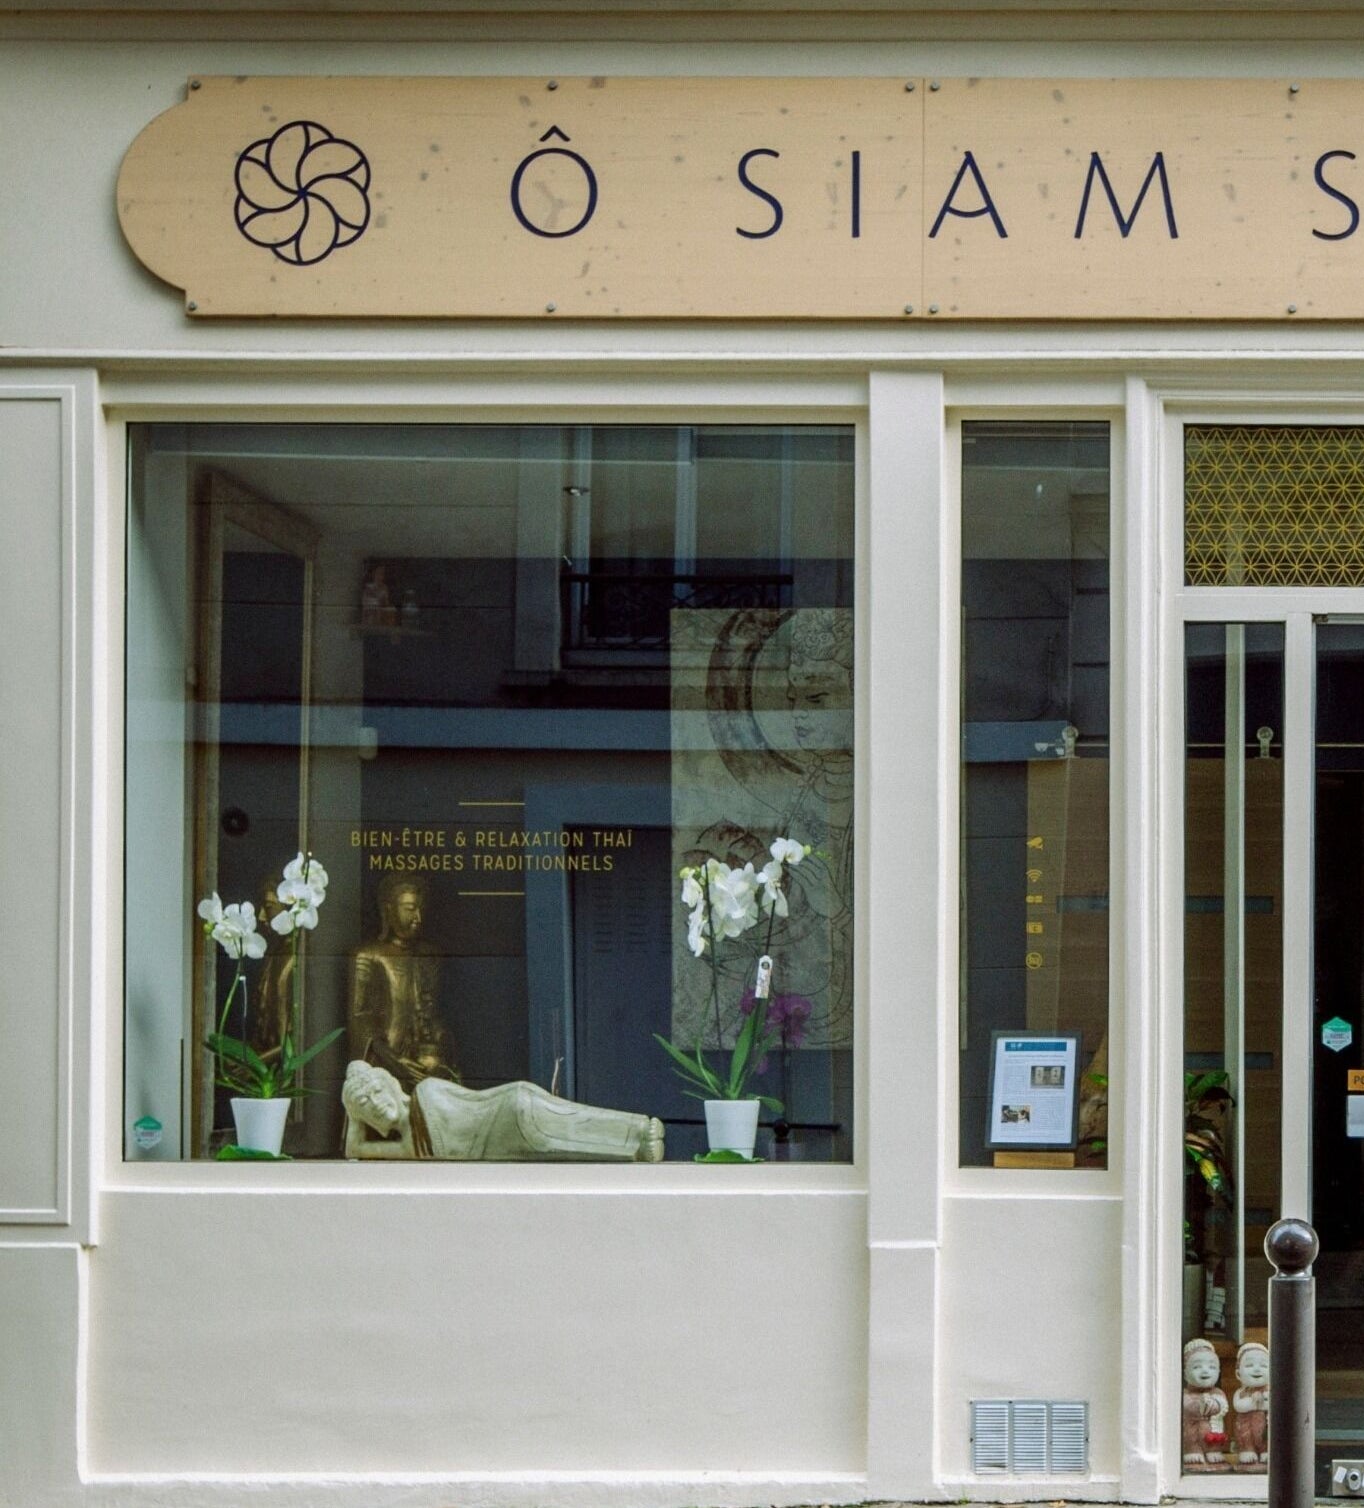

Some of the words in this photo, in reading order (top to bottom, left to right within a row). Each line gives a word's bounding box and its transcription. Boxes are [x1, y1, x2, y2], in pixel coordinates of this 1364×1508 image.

[509, 124, 598, 239] Ô
[735, 148, 1180, 240] SIAM
[350, 828, 446, 847] BIEN-ÊTRE
[455, 831, 466, 847] &
[475, 831, 584, 847] RELAXATION
[592, 830, 633, 847] THAÏ
[369, 854, 464, 871] MASSAGES
[472, 854, 614, 871] TRADITIONNELS
